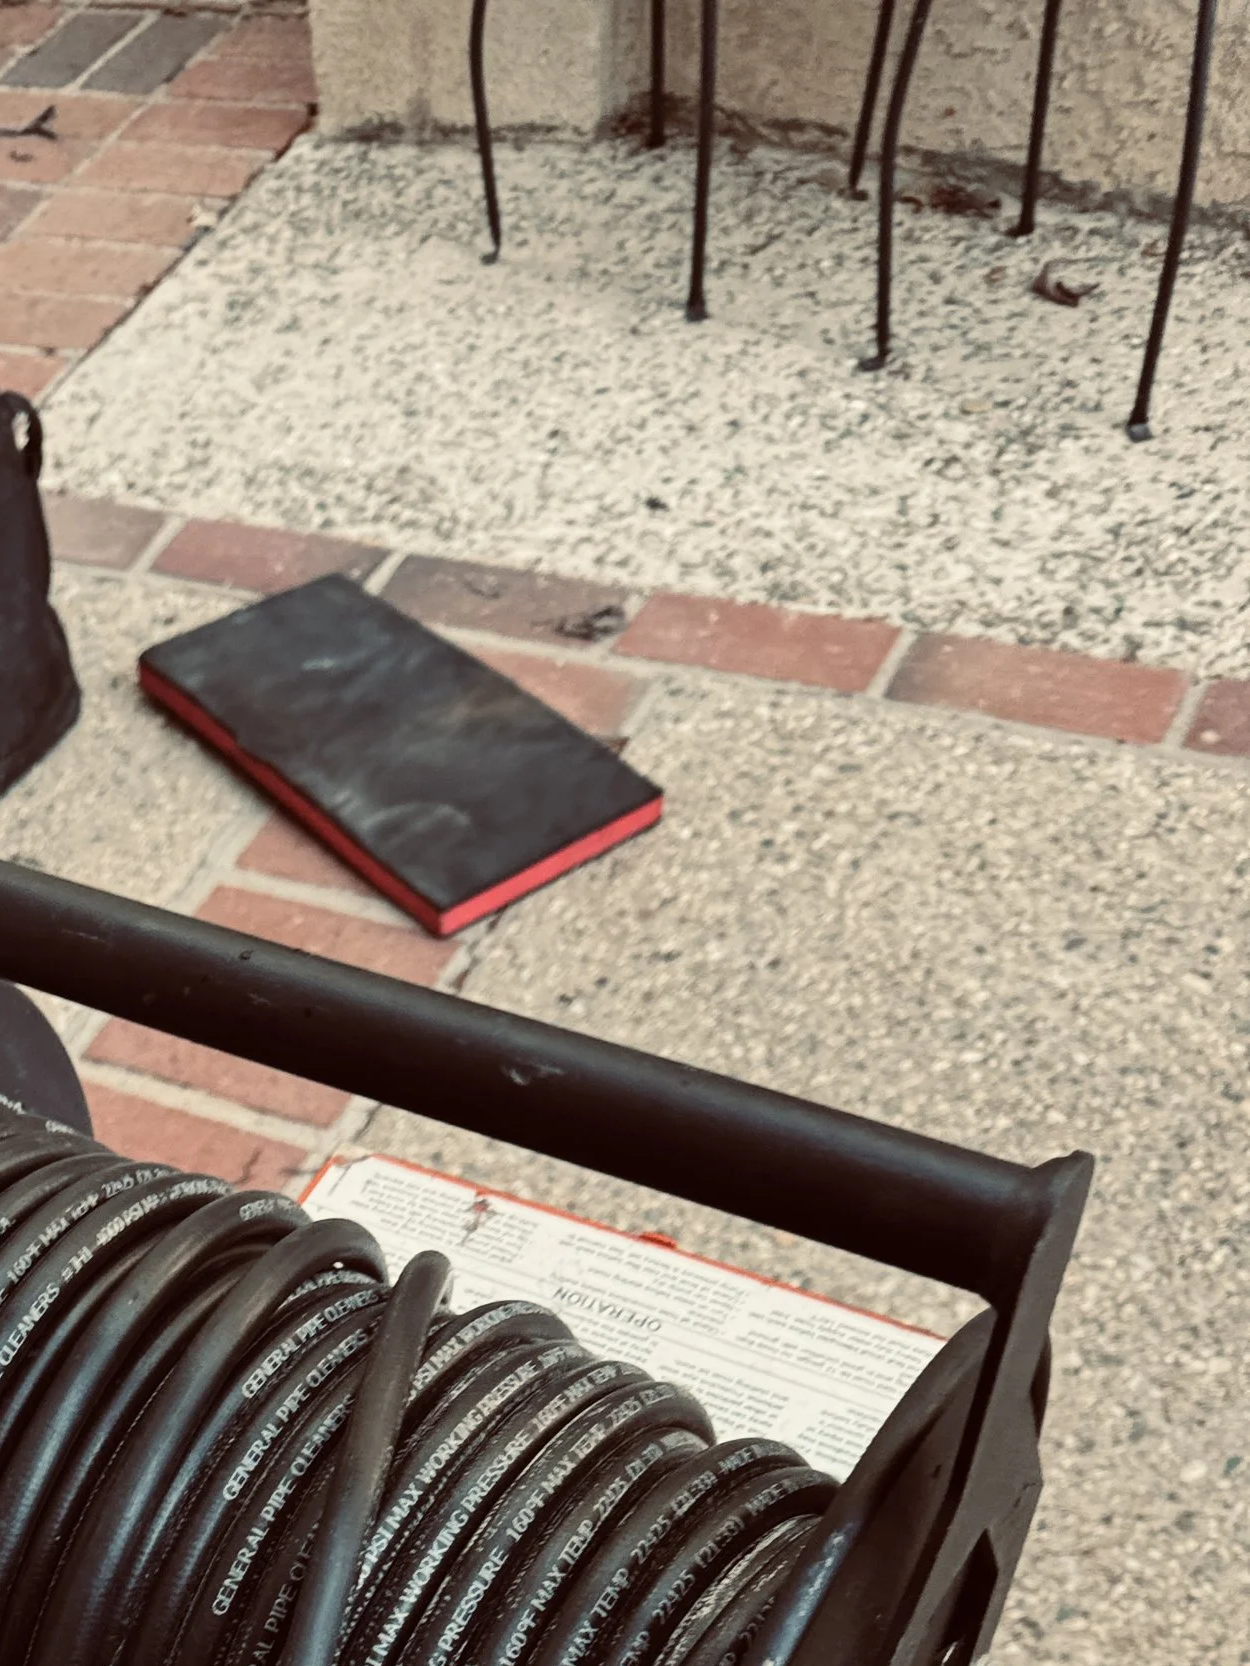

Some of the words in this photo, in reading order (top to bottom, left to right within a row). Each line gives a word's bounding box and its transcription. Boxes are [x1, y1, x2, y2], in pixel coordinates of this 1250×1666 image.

[242, 1336, 302, 1398] GENERAL
[294, 1313, 328, 1344] PIPE
[553, 1285, 662, 1334] OPERATION
[223, 1422, 284, 1500] GENERAL
[275, 1382, 311, 1423] PIPE
[306, 1328, 368, 1388] CLEANERS
[384, 1483, 424, 1530] MAX
[414, 1409, 484, 1484] WORKING
[212, 1526, 271, 1616] GENERAL
[260, 1476, 298, 1522] PIPE
[372, 1605, 409, 1657] MAX
[399, 1508, 470, 1603] WORKING
[460, 1430, 530, 1513] PRESSURE
[437, 1545, 510, 1652] PRESSURE
[540, 1455, 578, 1495] MAX
[568, 1423, 607, 1460] TEMP
[530, 1563, 567, 1613] MAX
[557, 1518, 594, 1566] TEMP
[264, 1583, 299, 1634] PIPE
[590, 1567, 630, 1618] TEMP
[651, 1567, 696, 1626] 22425
